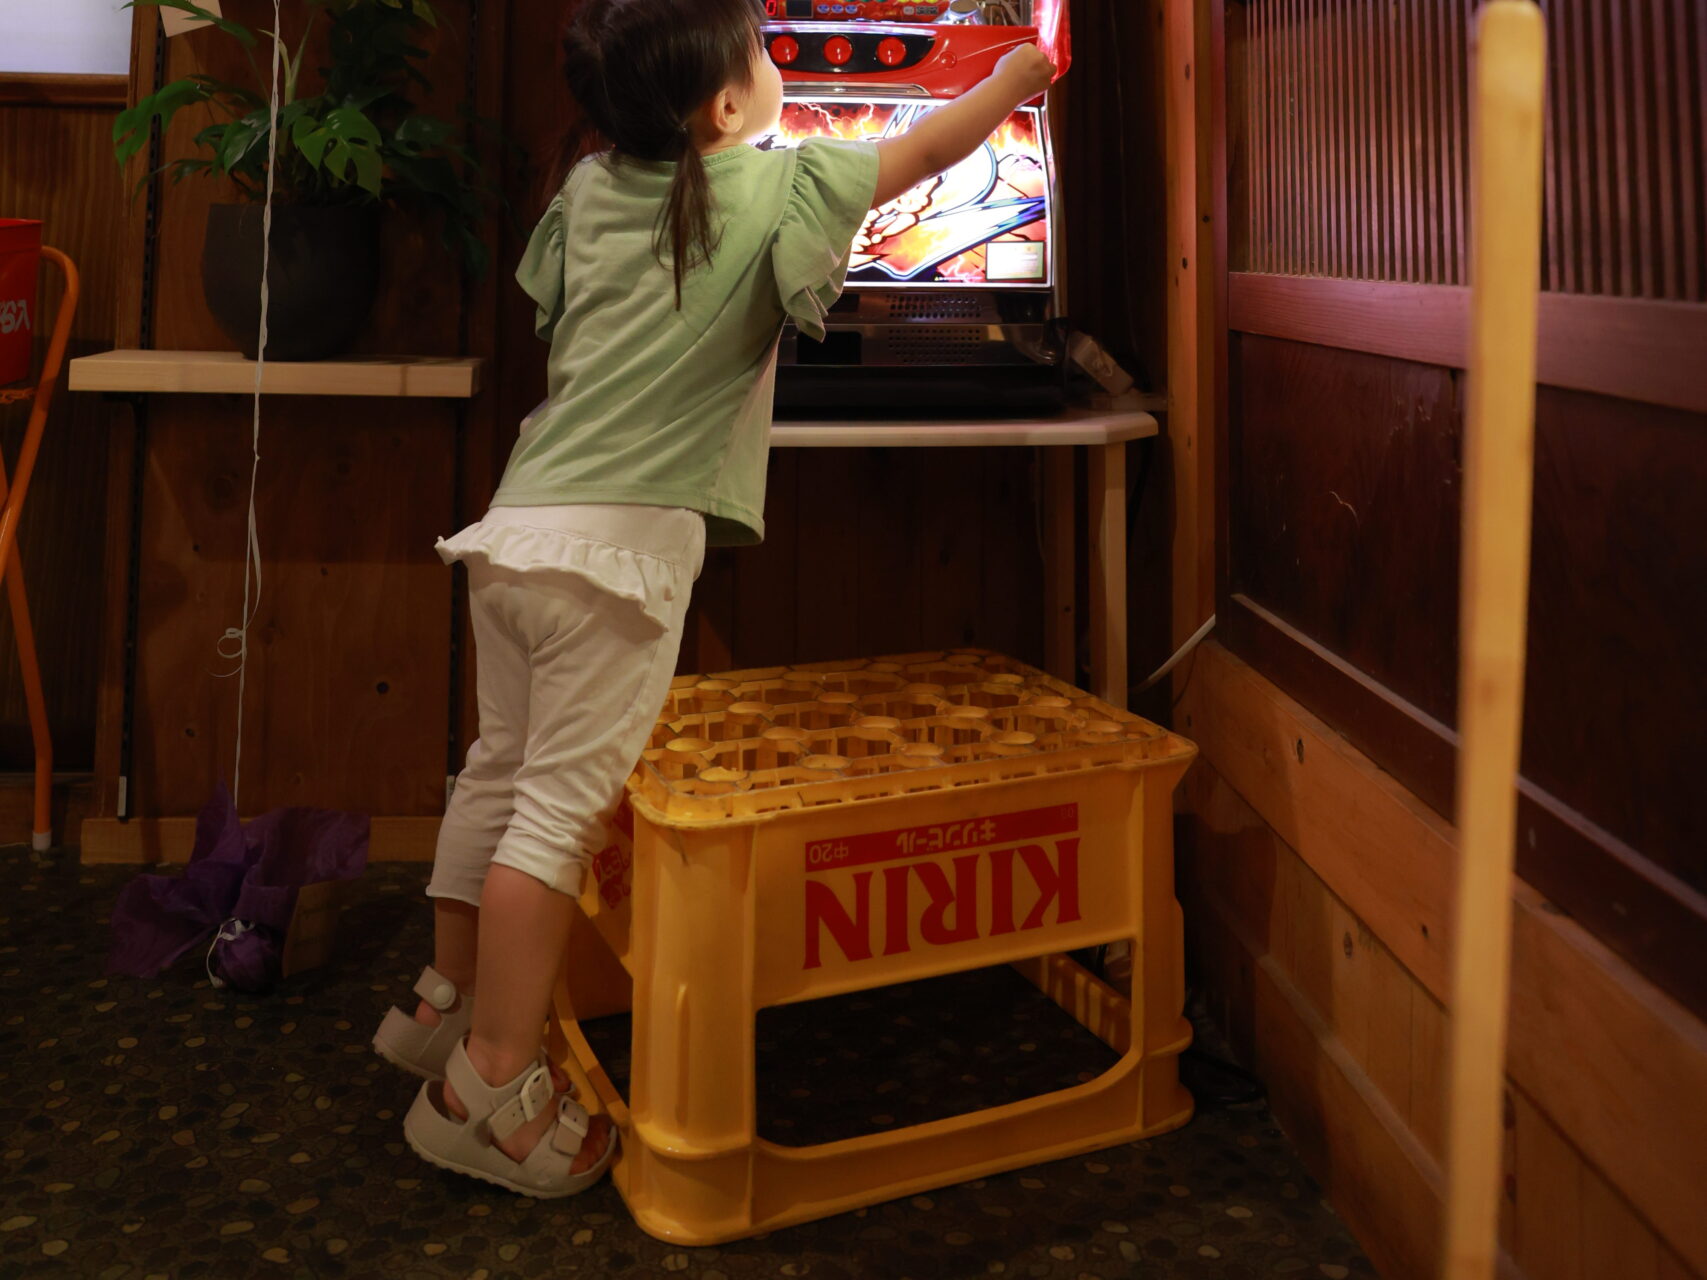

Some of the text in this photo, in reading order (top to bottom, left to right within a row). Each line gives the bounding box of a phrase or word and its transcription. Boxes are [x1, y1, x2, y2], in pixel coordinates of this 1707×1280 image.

[896, 819, 997, 855] キリンビール
[801, 837, 1082, 970] KIRIN
